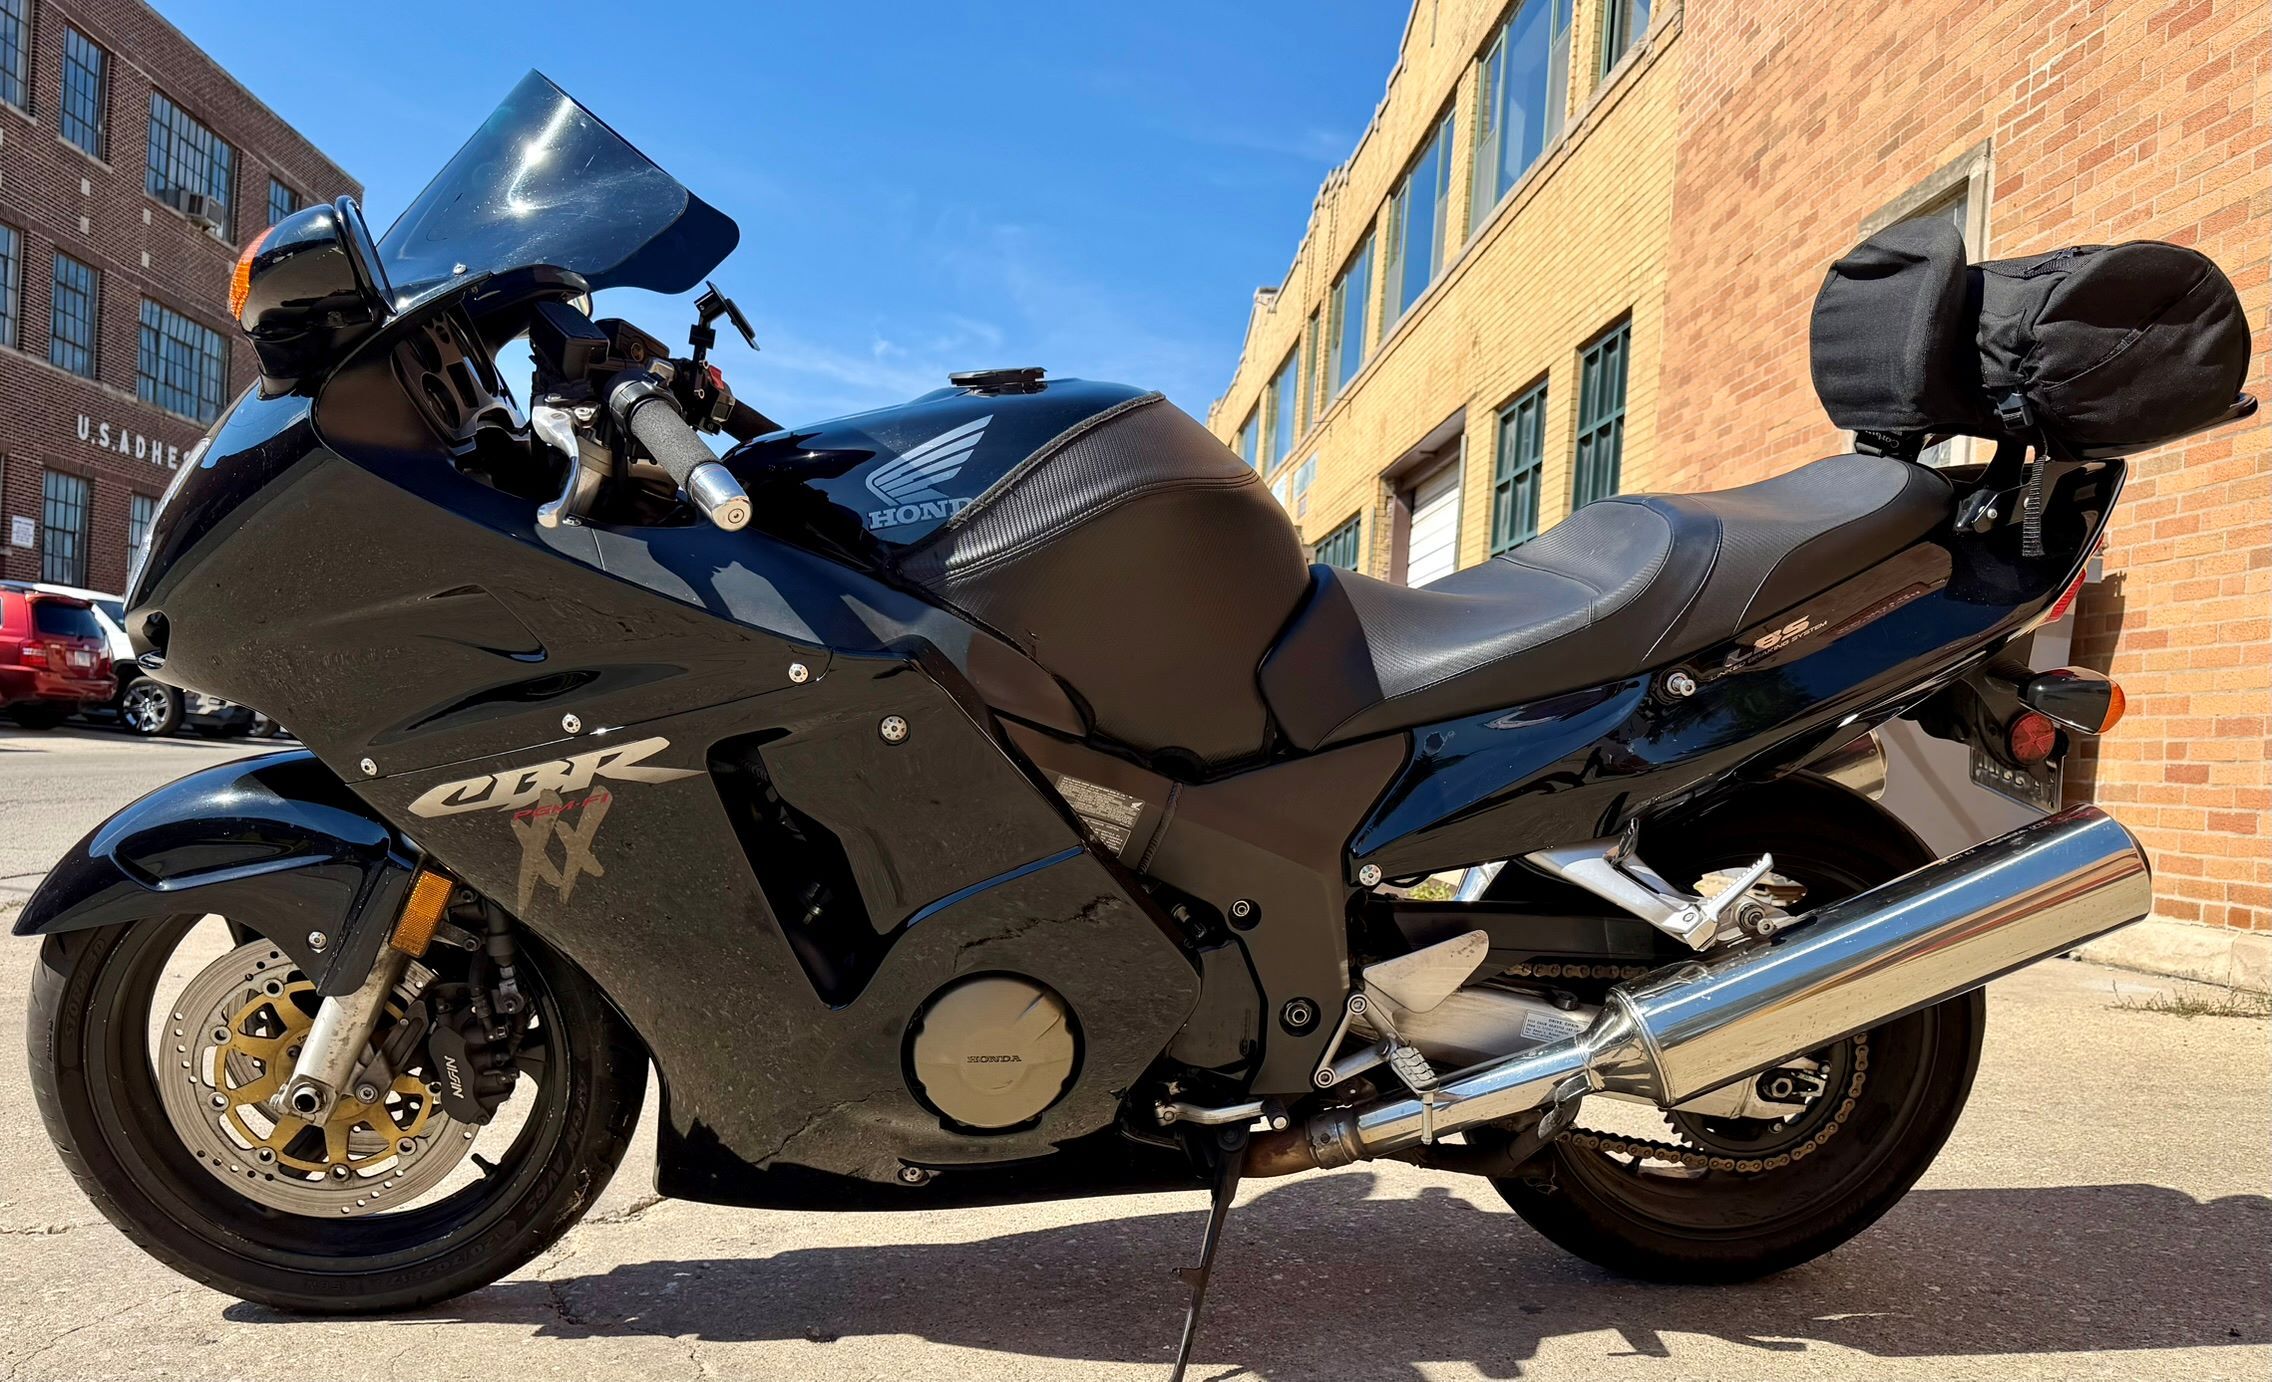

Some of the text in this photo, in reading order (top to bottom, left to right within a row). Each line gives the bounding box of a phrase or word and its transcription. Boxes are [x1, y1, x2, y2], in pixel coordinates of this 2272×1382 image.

[1747, 640, 1790, 664] BRAKING
[1791, 620, 1828, 643] SYSTEM
[408, 736, 706, 818] CBR
[510, 785, 613, 920] XX
[444, 1055, 464, 1099] NISSIN
[966, 1055, 1022, 1063] HONDA
